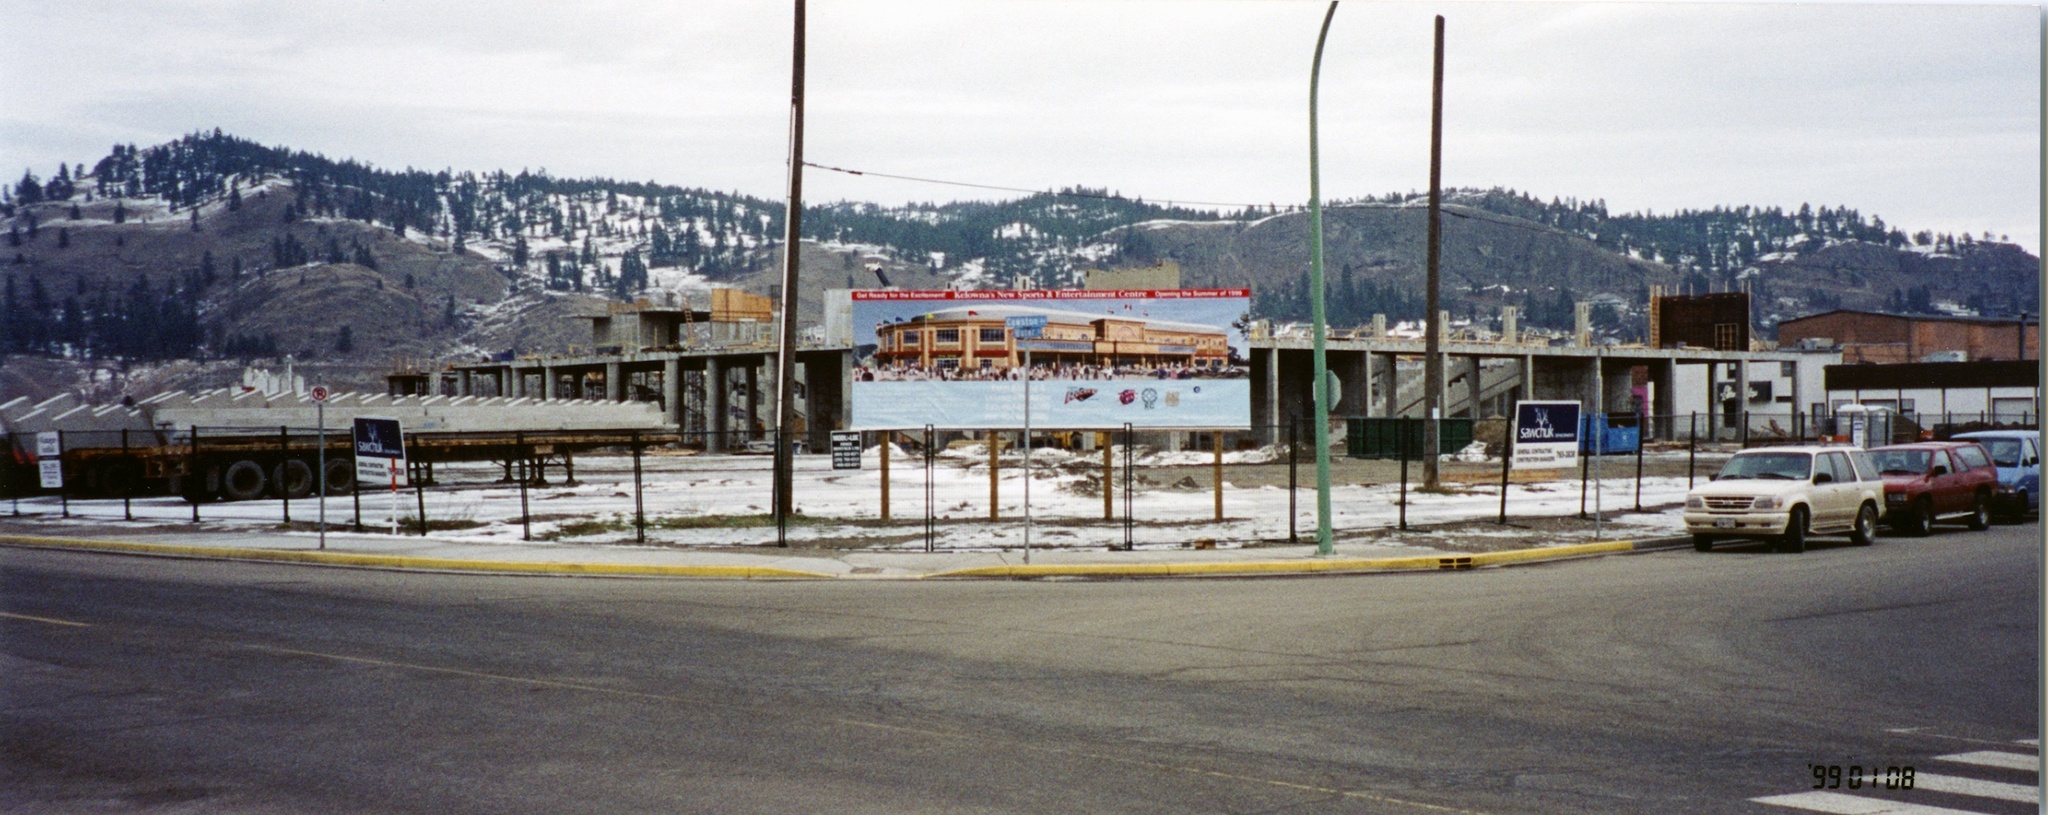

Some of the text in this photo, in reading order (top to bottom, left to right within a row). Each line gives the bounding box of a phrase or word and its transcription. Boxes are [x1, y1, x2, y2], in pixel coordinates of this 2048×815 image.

[869, 292, 888, 300] Ready
[955, 291, 995, 299] Kelowna's
[997, 291, 1015, 299] New
[1017, 291, 1044, 300] Sports
[1056, 290, 1116, 298] Entertainment
[1118, 290, 1148, 298] Centre
[1155, 291, 1181, 299] Opening
[1006, 317, 1038, 327] Cawston
